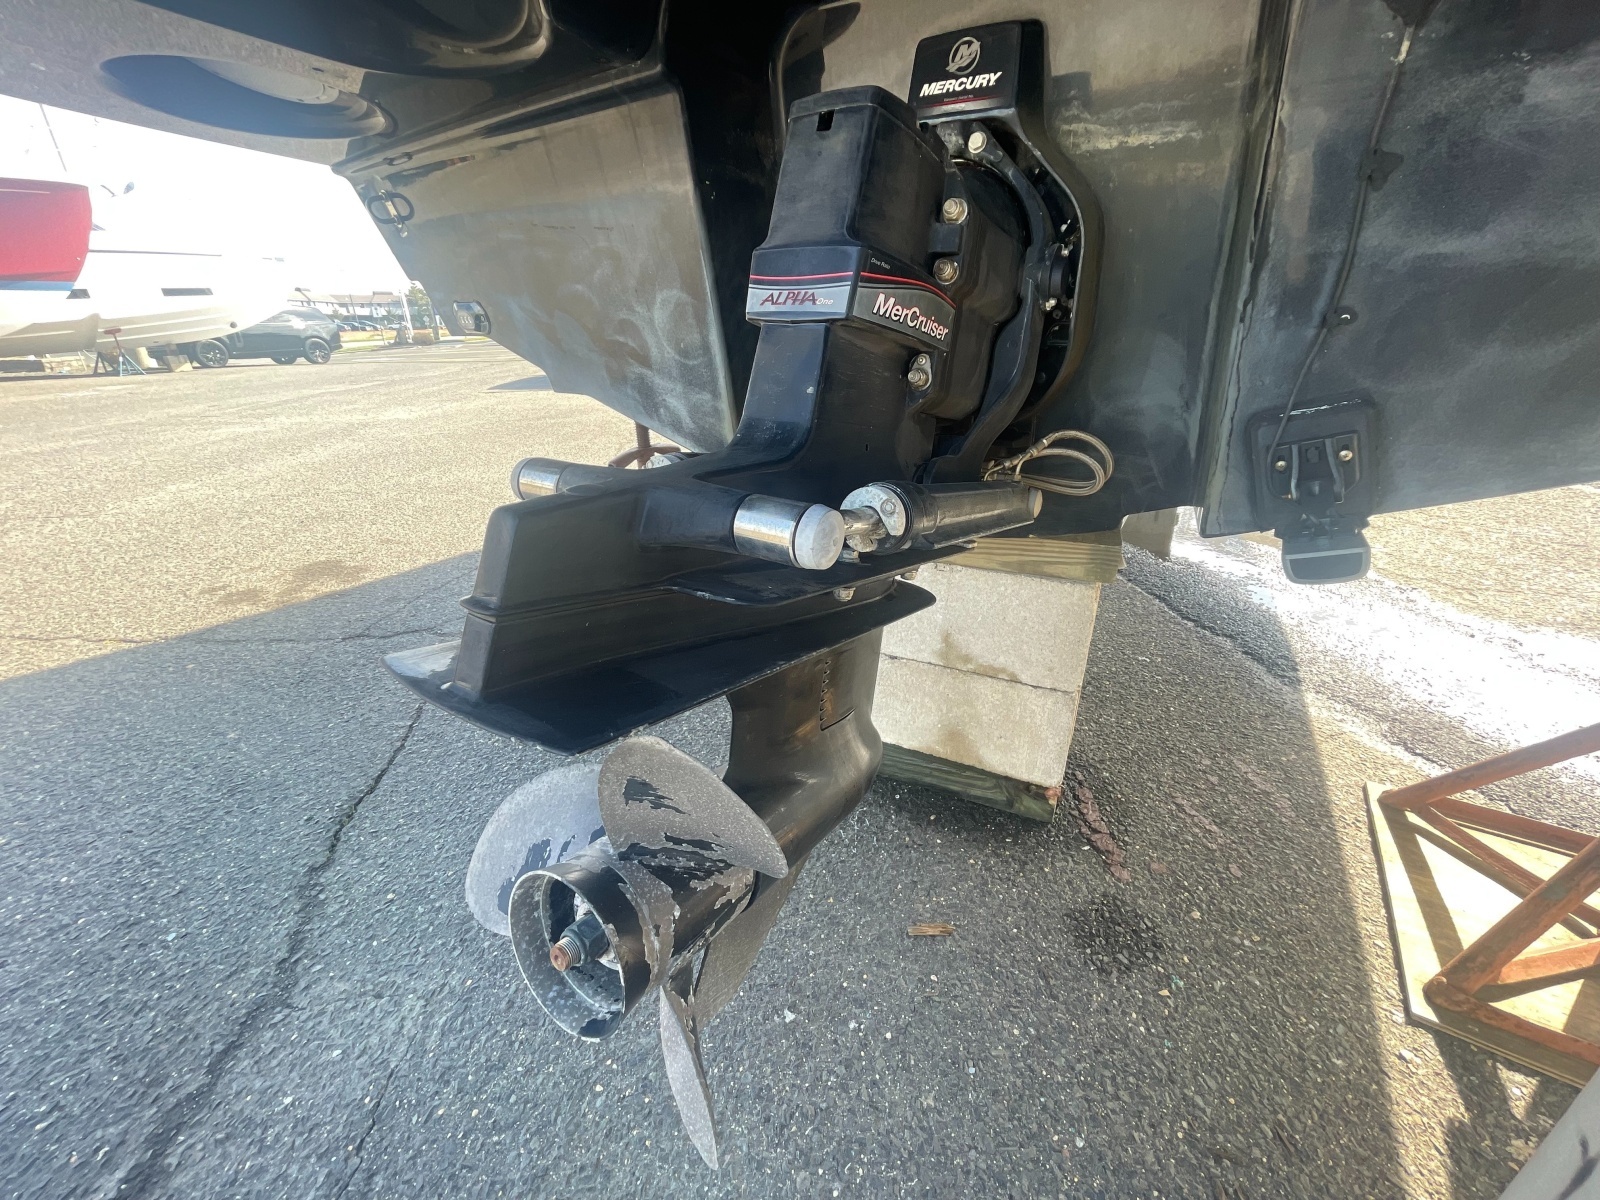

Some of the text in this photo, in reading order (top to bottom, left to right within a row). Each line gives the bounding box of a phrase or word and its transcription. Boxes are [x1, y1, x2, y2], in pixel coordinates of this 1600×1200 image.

[919, 71, 1002, 97] MERCURY
[759, 290, 834, 306] ALPHA One
[872, 292, 949, 342] MerCruiser
